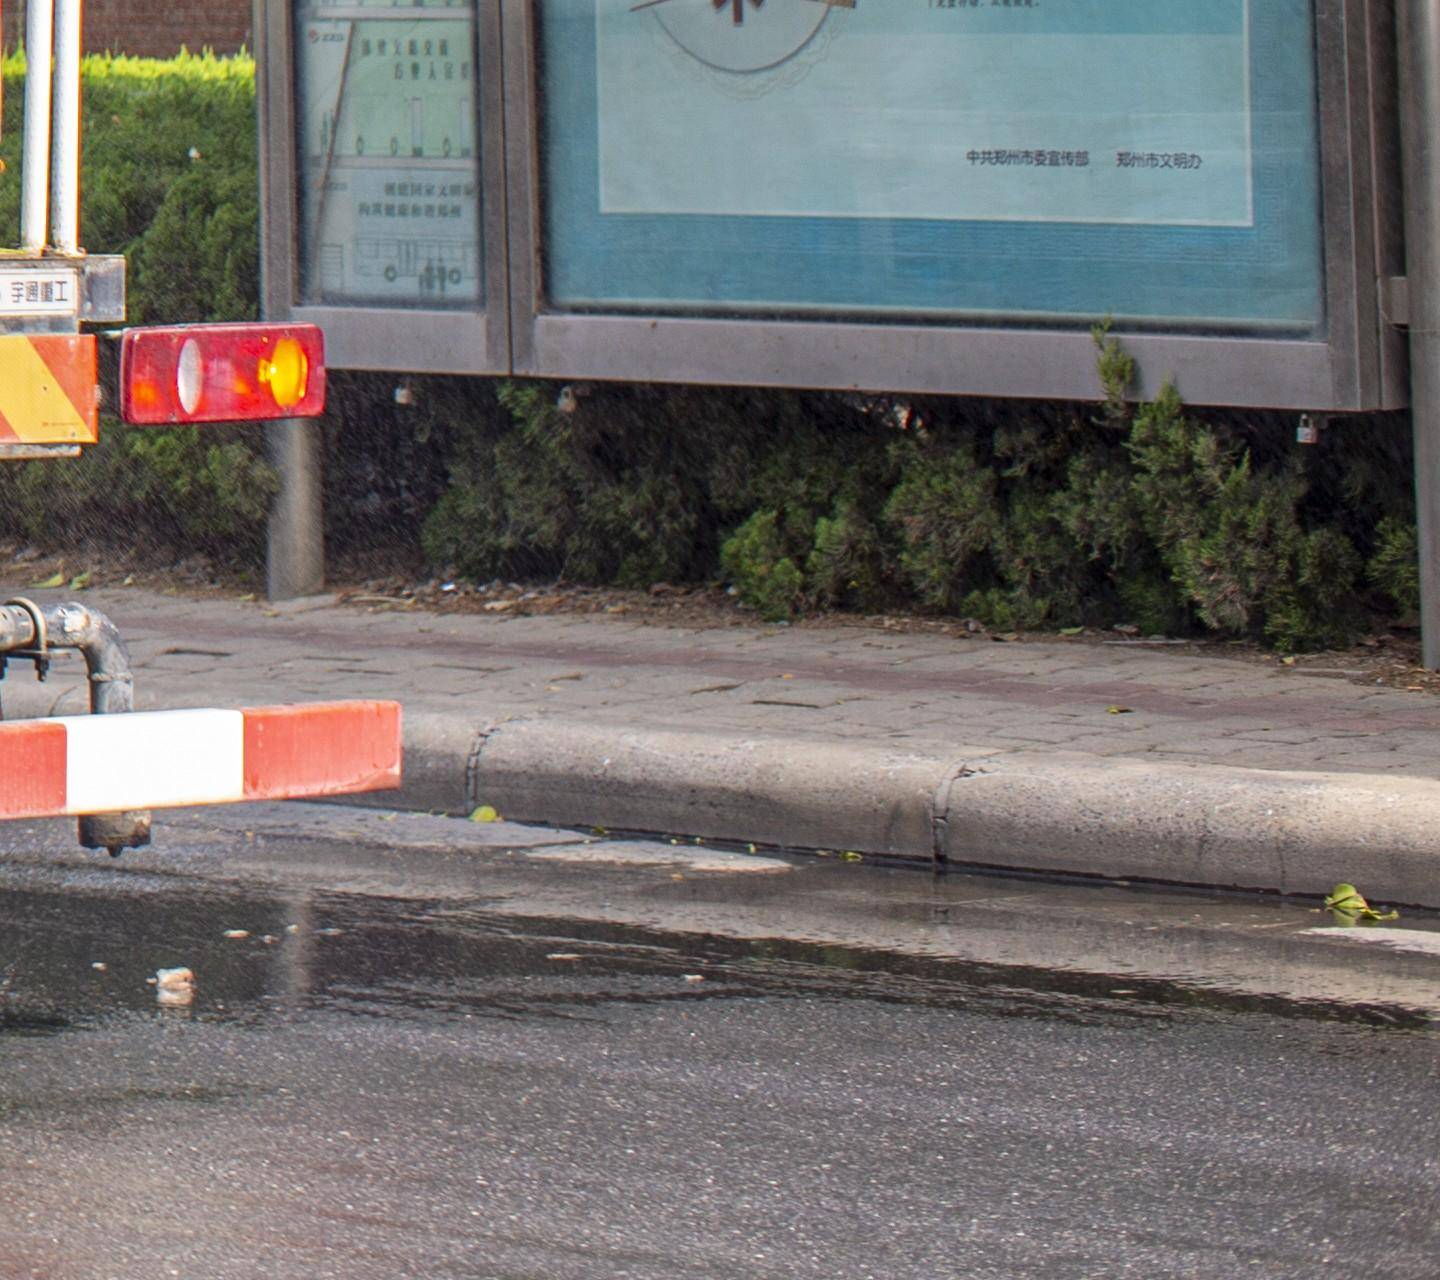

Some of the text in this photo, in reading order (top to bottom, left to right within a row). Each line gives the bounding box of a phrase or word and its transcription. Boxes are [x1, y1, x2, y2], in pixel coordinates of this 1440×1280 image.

[966, 148, 1203, 170] 中共郑州市委宣传部 郑州市文明办
[10, 279, 68, 304] 宇通重工
